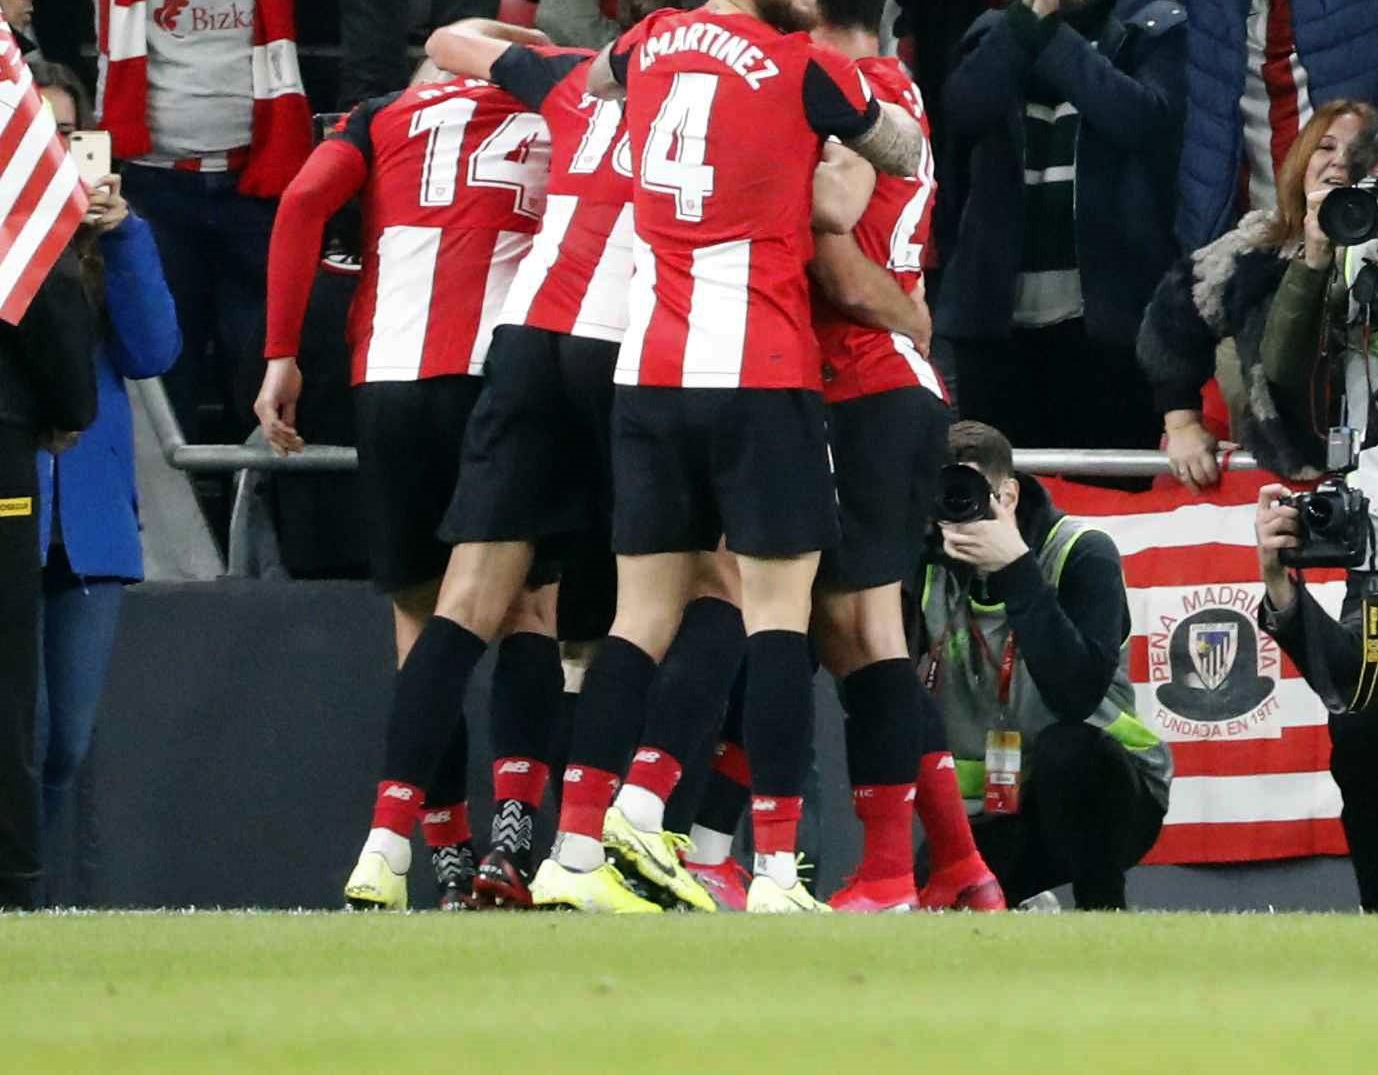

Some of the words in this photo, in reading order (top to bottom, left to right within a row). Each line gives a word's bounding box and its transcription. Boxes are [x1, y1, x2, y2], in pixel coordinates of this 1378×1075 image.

[191, 2, 254, 32] Bizk
[399, 97, 554, 221] 14
[641, 72, 720, 223] 4
[1226, 720, 1249, 736] EN
